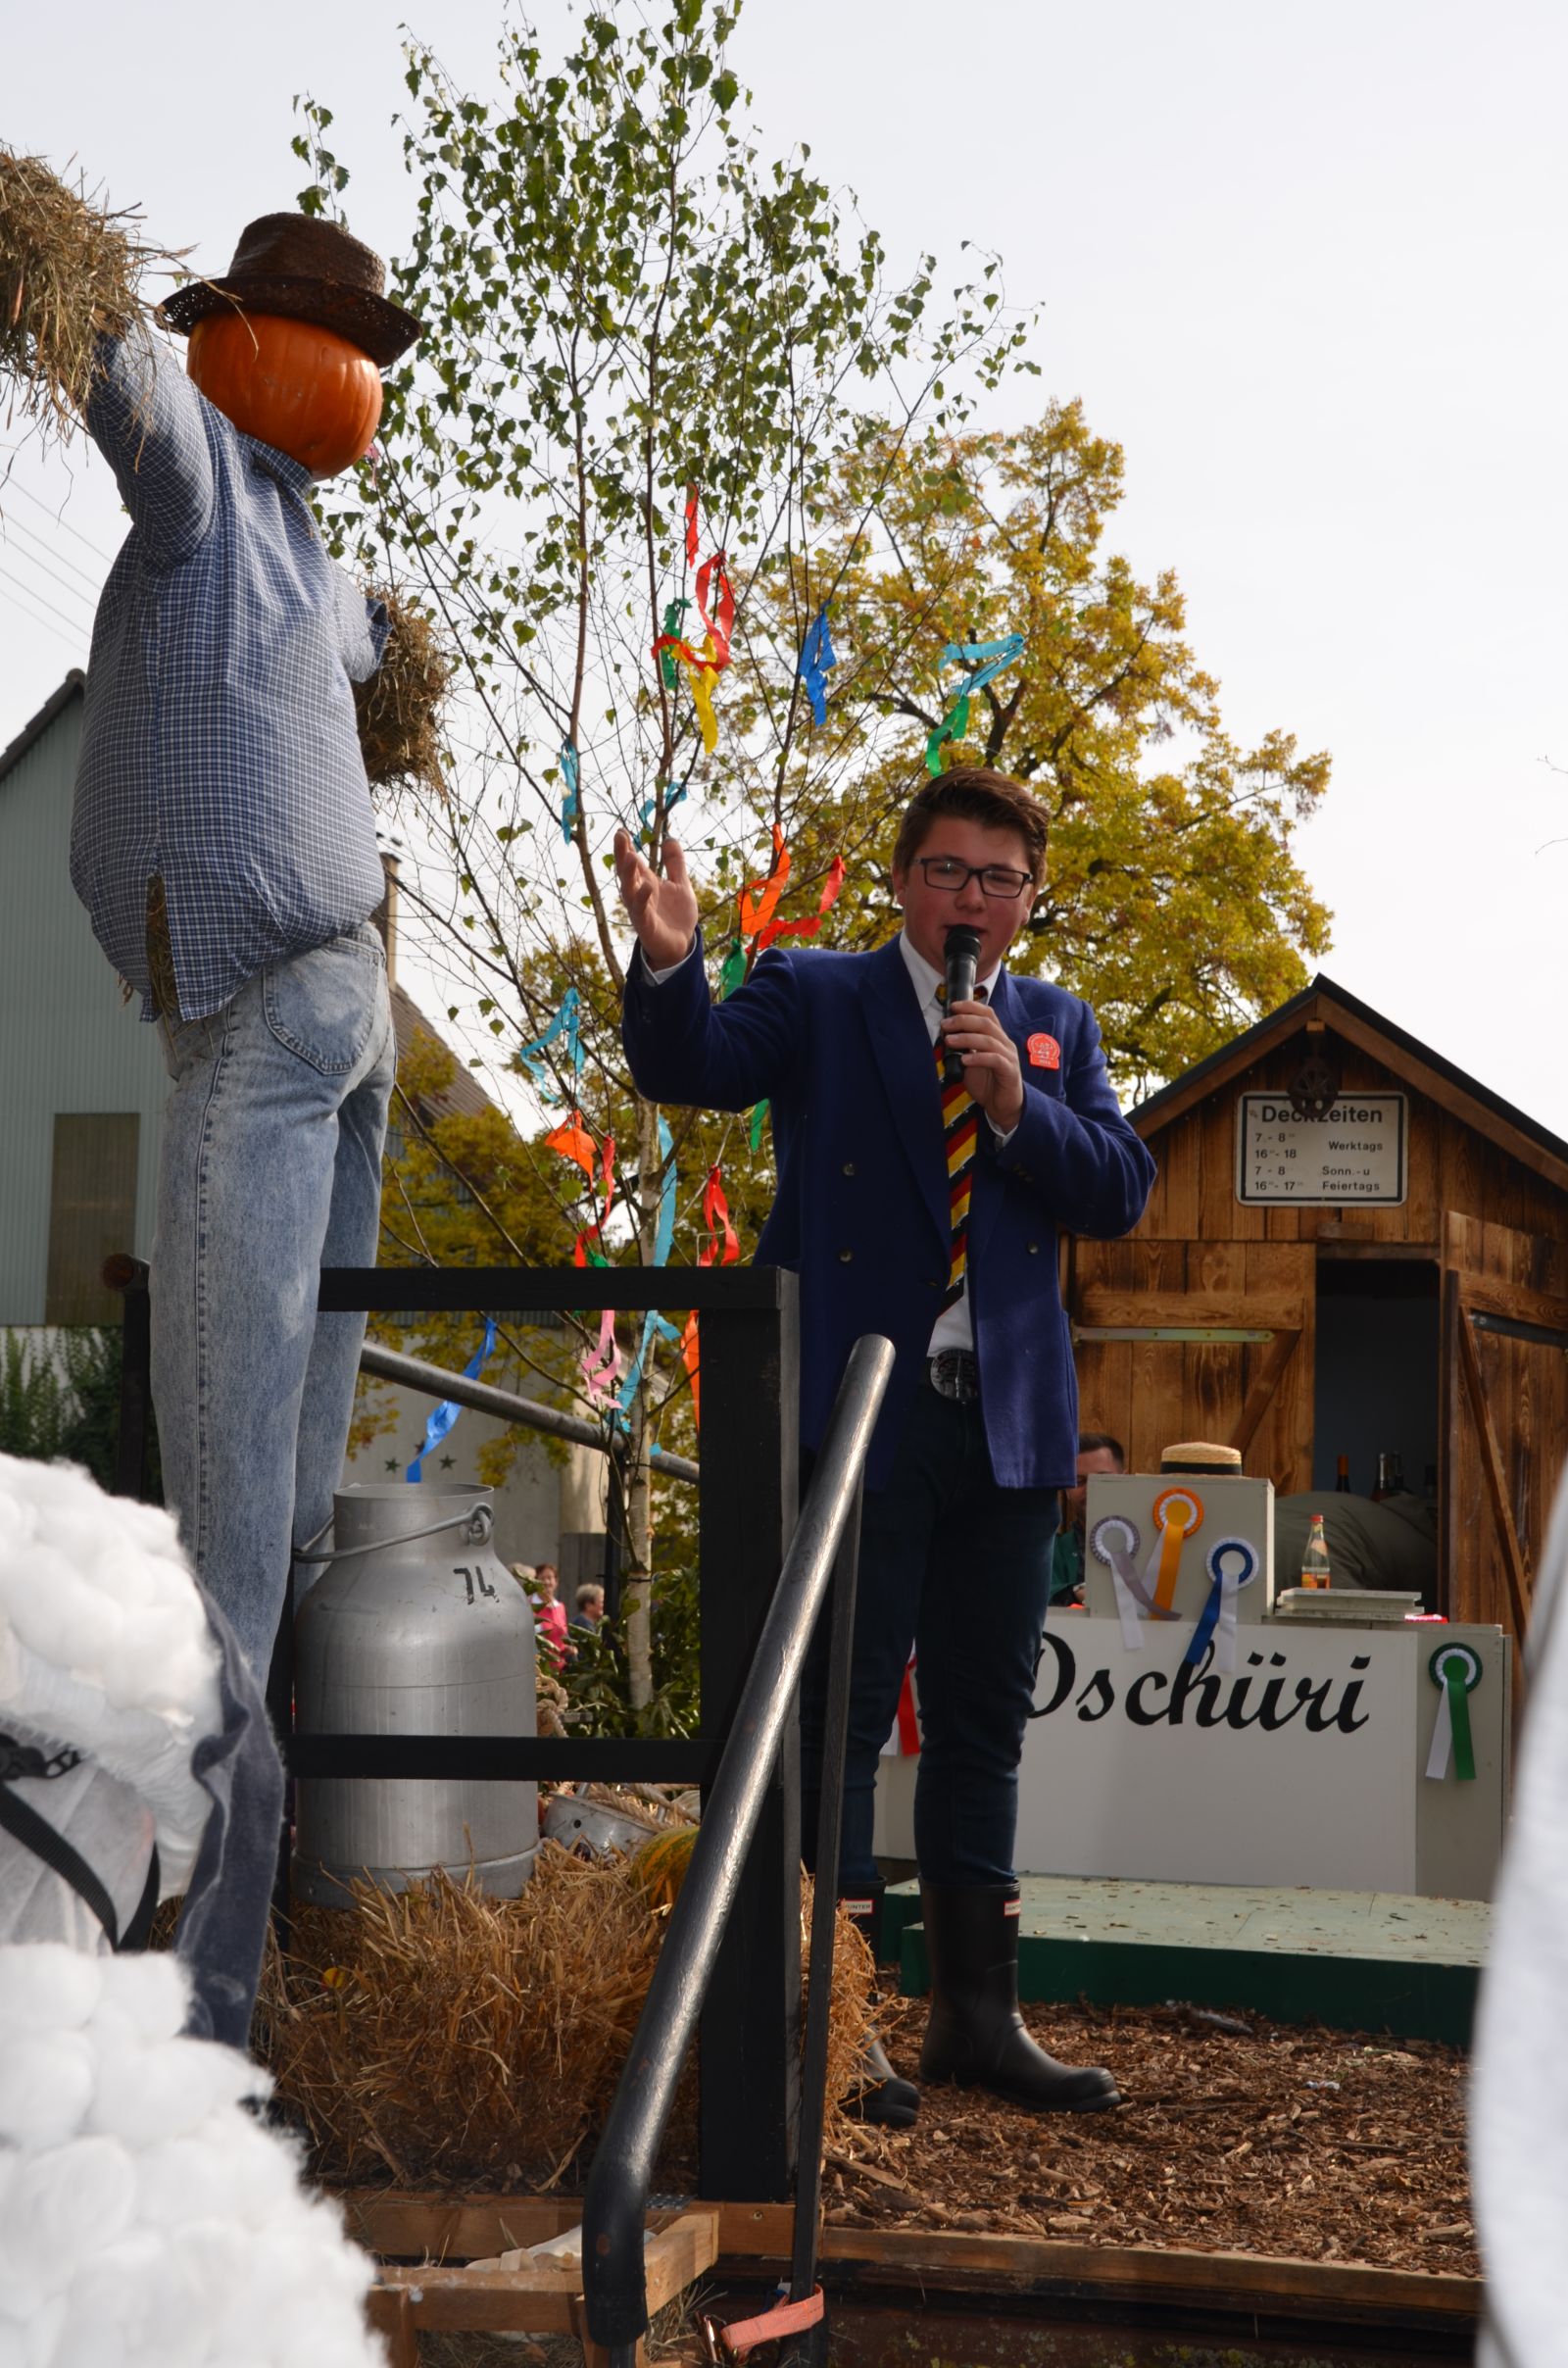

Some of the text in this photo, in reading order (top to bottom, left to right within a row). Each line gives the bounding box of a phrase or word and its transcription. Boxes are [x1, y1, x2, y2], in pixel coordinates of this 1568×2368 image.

[1329, 1141, 1383, 1153] Werktags
[1322, 1180, 1380, 1192] Feiertags
[1026, 1630, 1371, 1733] Dschüri
